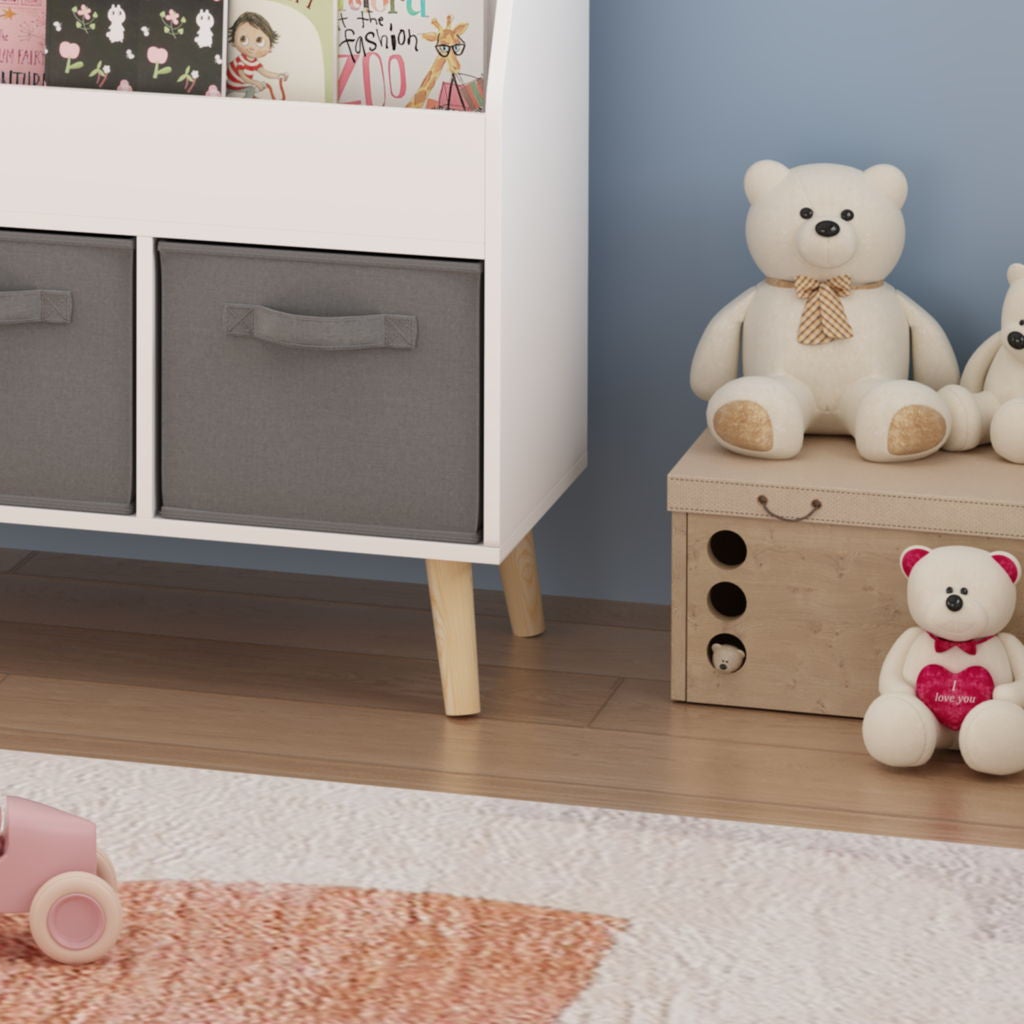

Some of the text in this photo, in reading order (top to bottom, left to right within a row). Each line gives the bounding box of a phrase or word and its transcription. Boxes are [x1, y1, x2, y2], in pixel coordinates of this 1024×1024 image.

[357, 11, 384, 28] the
[339, 23, 419, 63] fashion
[338, 52, 407, 107] ZOO
[951, 680, 957, 692] I
[934, 692, 976, 706] love you
